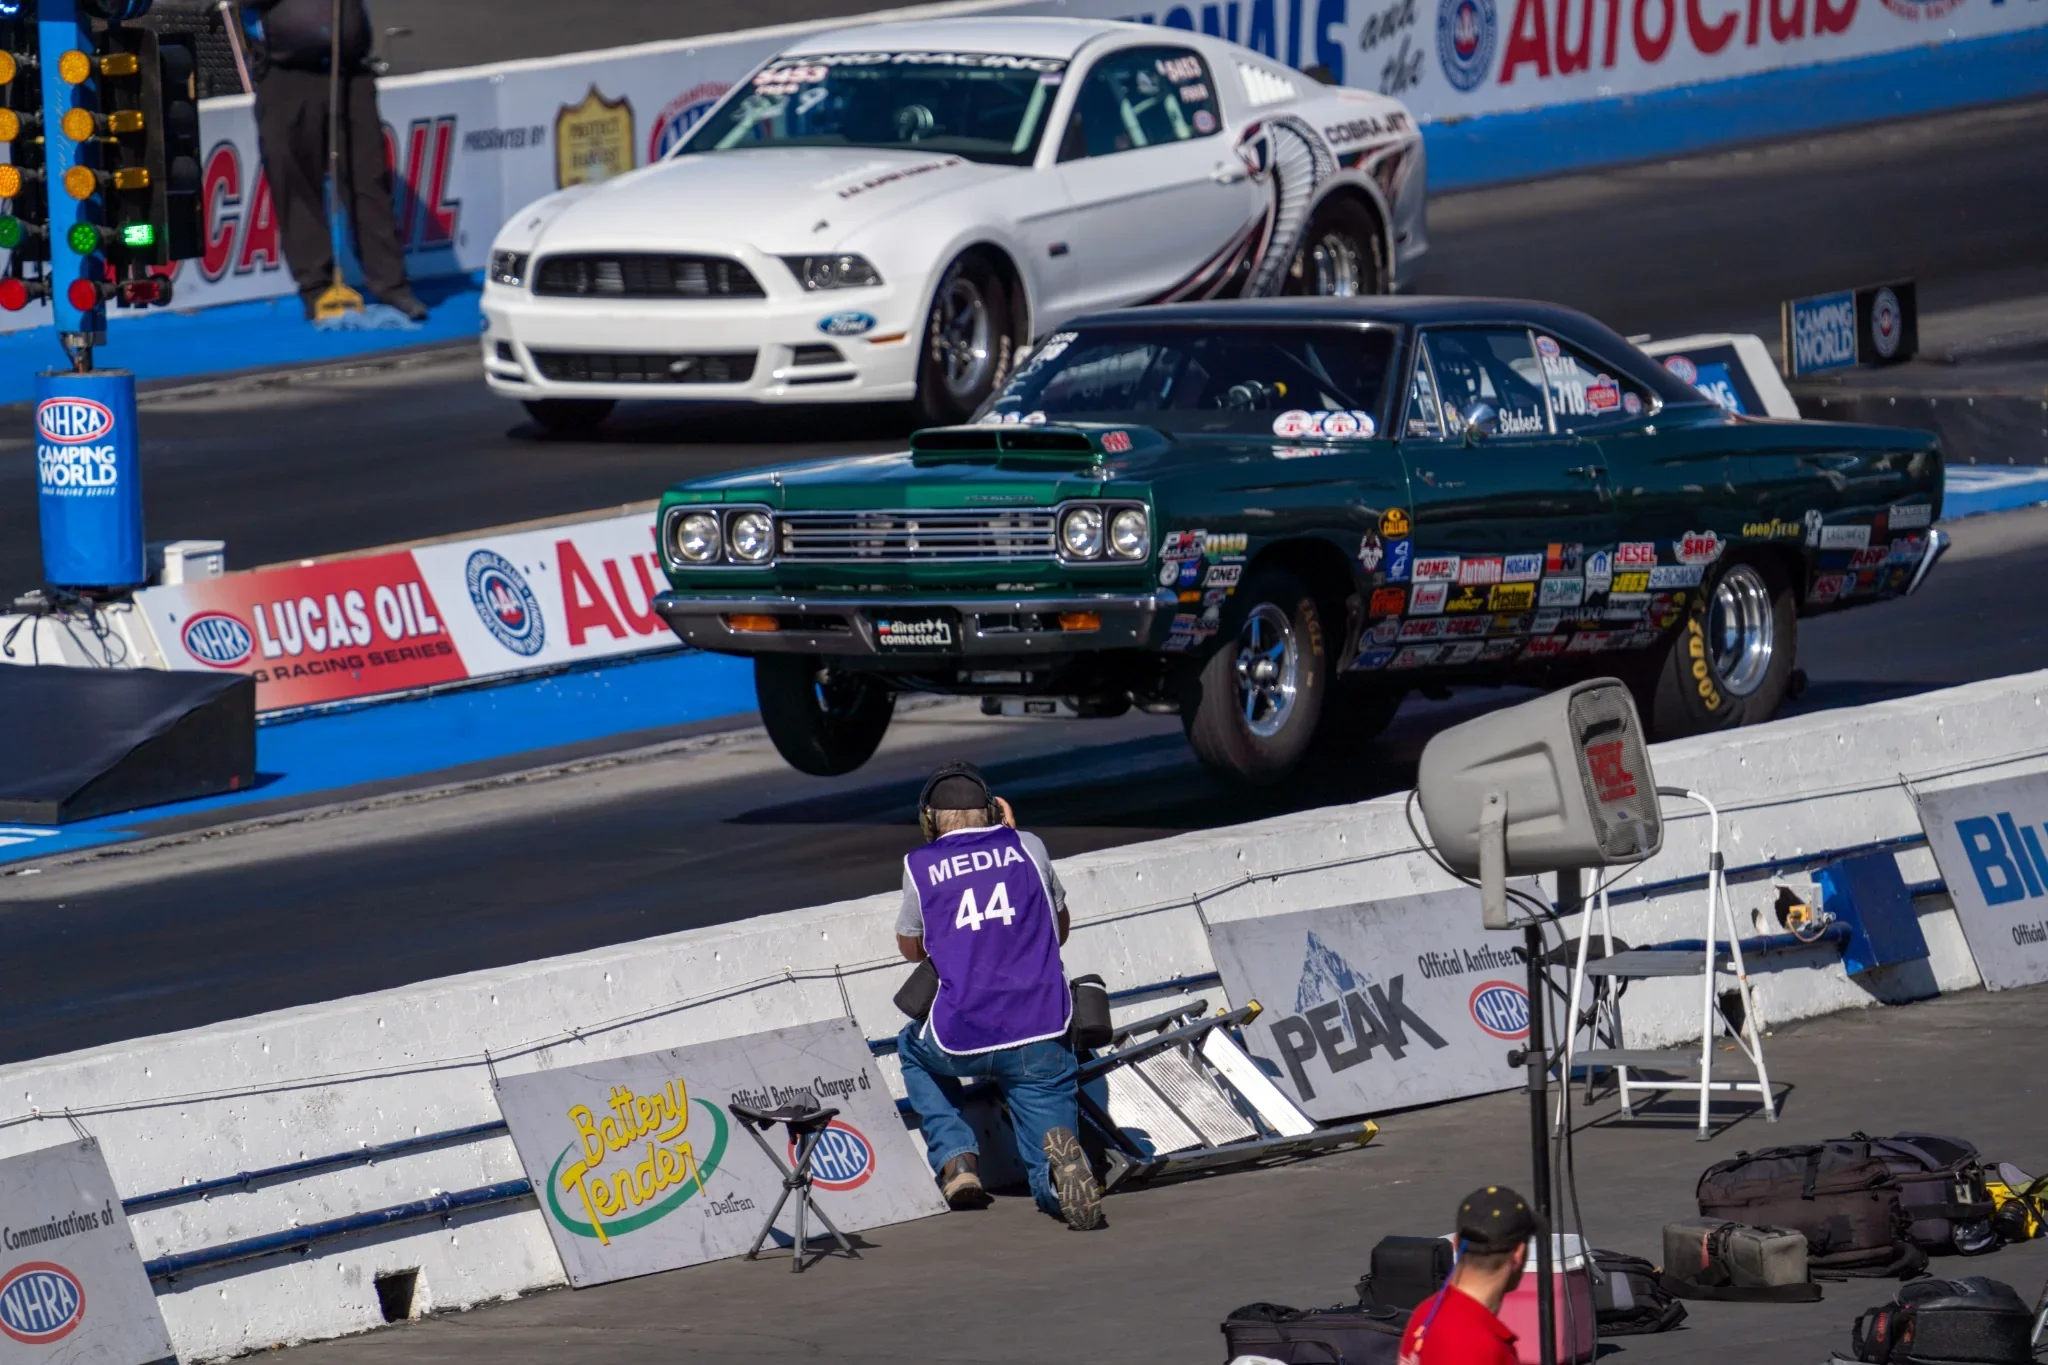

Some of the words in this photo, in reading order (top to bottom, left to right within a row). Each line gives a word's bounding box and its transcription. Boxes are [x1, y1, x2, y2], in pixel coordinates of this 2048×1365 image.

[531, 125, 545, 146] BY
[1324, 118, 1382, 146] COBRA
[1797, 300, 1853, 334] CAMPING
[1800, 325, 1854, 367] WORLD
[42, 404, 102, 436] NHRA
[38, 445, 116, 464] CAMPING
[40, 463, 118, 487] WORLD
[1506, 557, 1540, 576] HOGAN'S
[1615, 543, 1656, 564] JESEL
[1682, 538, 1716, 556] SRP
[556, 525, 664, 646] Au
[1416, 561, 1449, 577] COMP
[1460, 558, 1503, 586] Autolite
[252, 584, 374, 659] LUCAS
[375, 581, 438, 642] OIL
[185, 620, 253, 662] NHRA
[272, 654, 365, 681] RACING
[367, 640, 454, 667] SERIES
[928, 846, 1024, 886] MEDIA
[956, 882, 1016, 931] 44
[2012, 920, 2047, 946] Official
[1418, 948, 1464, 979] Official
[1463, 943, 1527, 973] Antifreez
[1478, 990, 1529, 1030] NHRA
[1269, 973, 1450, 1103] PEAK
[770, 1084, 811, 1106] Batty
[813, 1075, 857, 1101] Charger
[857, 1067, 871, 1090] of
[568, 1078, 688, 1169] Battery
[560, 1141, 707, 1246] Tender
[3, 1210, 99, 1251] Communications
[101, 1199, 115, 1226] of
[4, 1275, 75, 1330] NHRA
